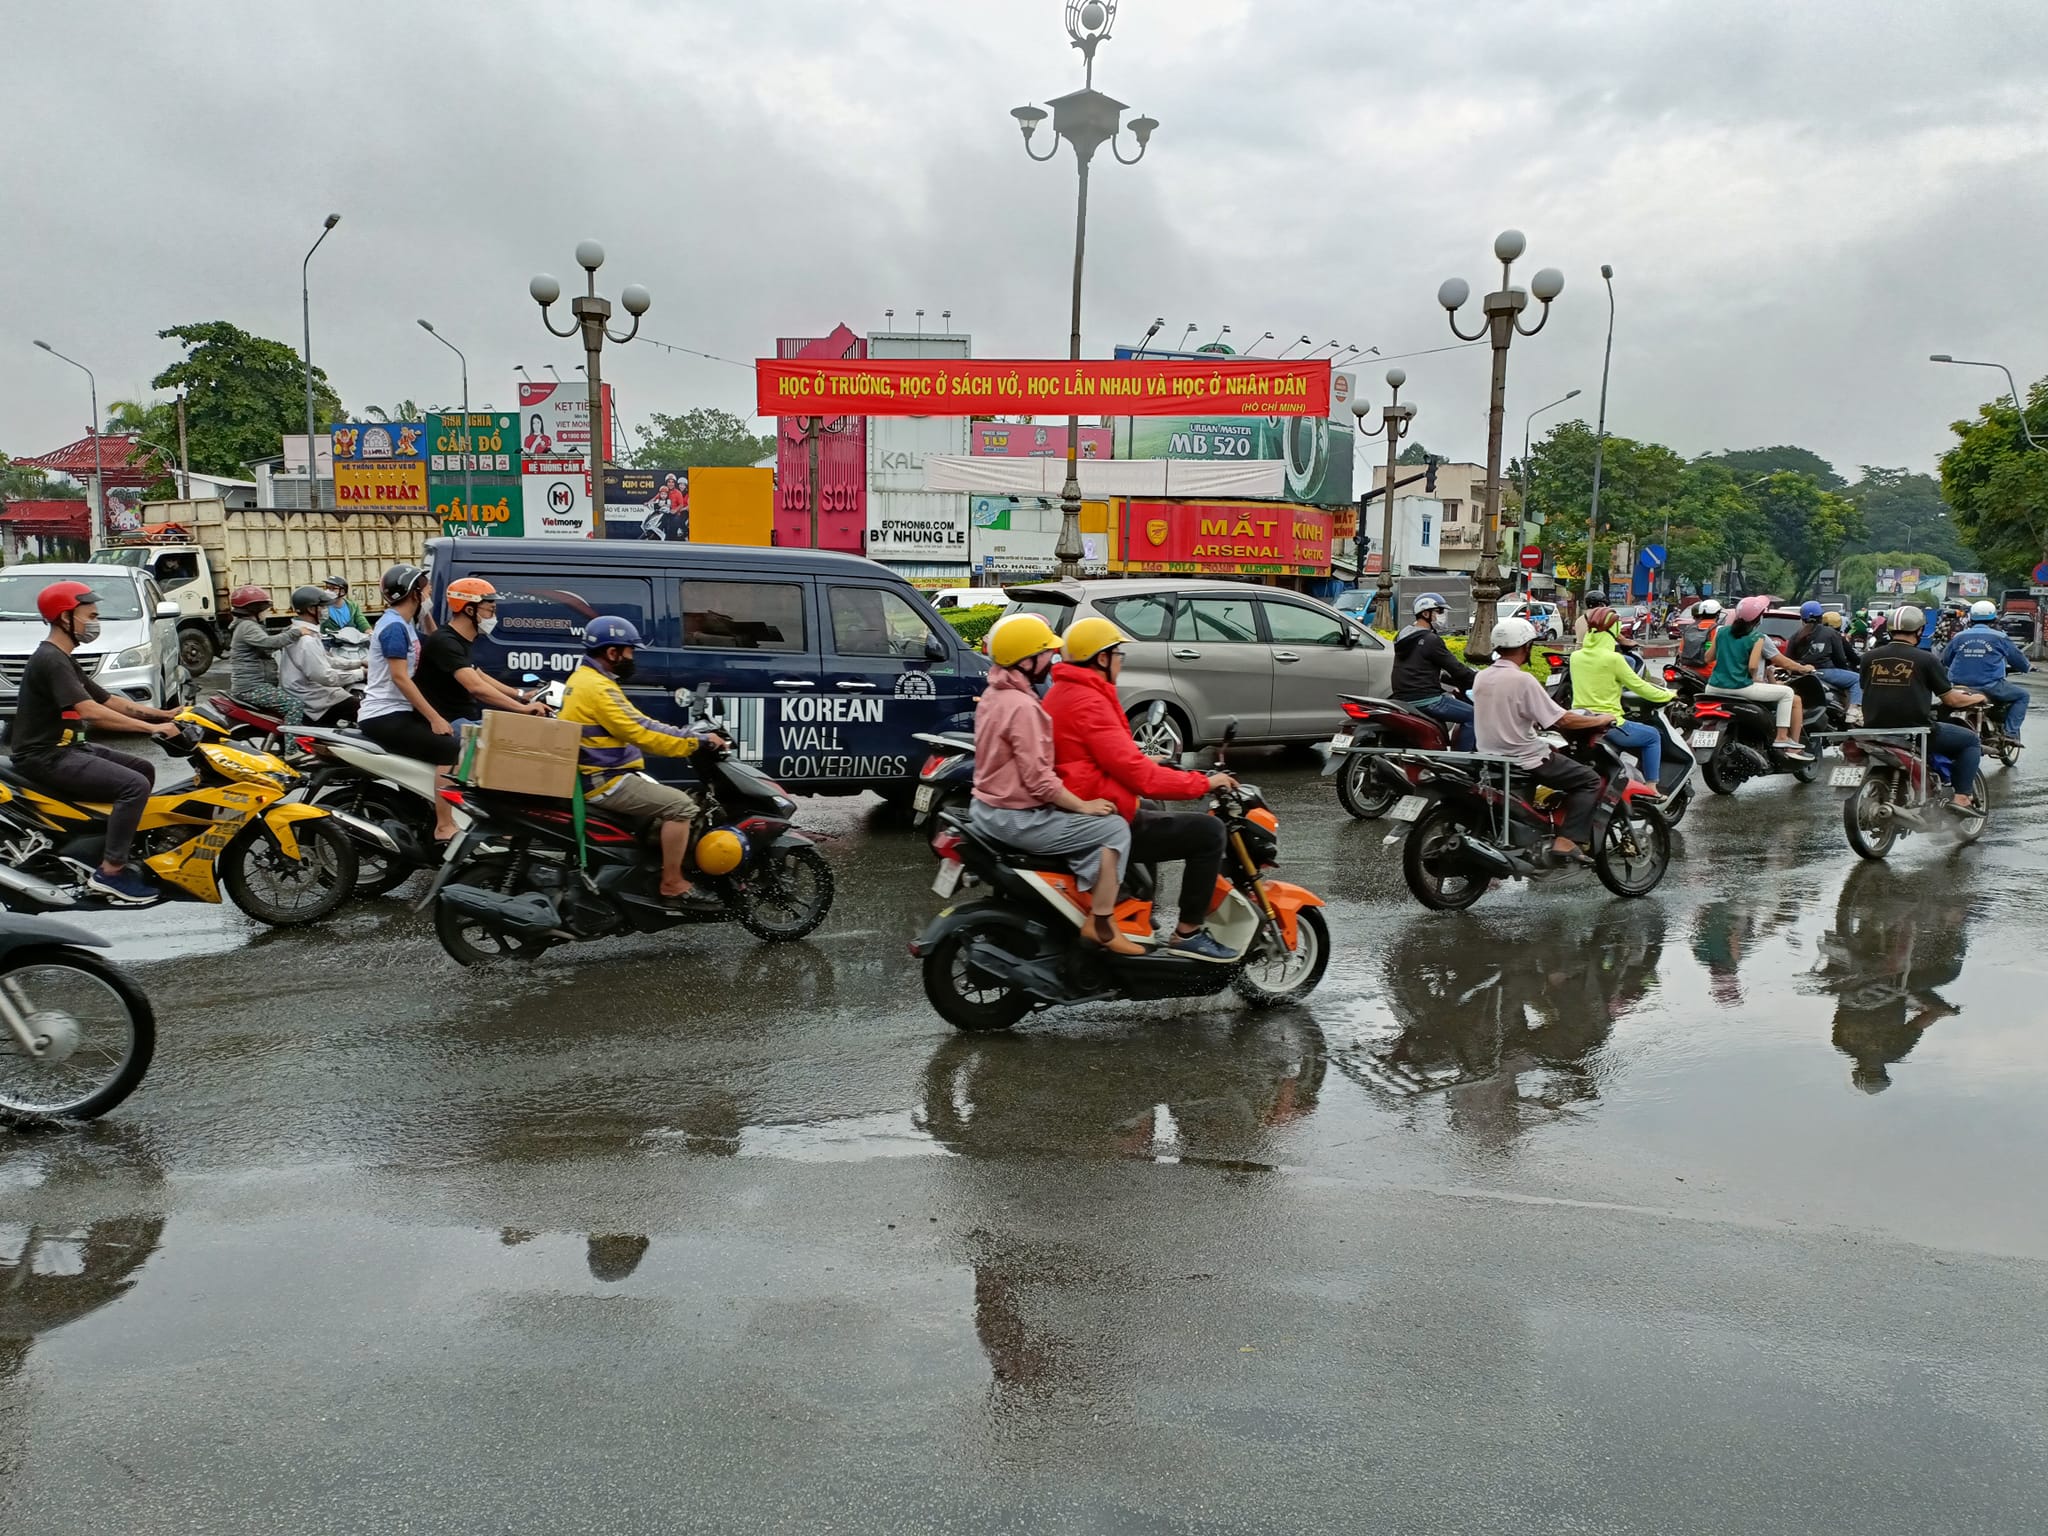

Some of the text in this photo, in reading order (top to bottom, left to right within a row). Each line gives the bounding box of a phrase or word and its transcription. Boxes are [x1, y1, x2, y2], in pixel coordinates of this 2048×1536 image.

[779, 369, 1307, 399] HỌC Ở TRƯỜNG, HỌC Ở SÁCH VỞ, HỌC LẪN NHAU VÀ HỌC Ở NHÂN DÂN
[1261, 402, 1277, 412] CHÍ
[1280, 402, 1306, 414] MINH)
[1189, 423, 1252, 435] URBAN MASTER
[478, 428, 502, 452] ĐỒ
[1168, 433, 1251, 456] MB 520
[528, 460, 579, 473] HỆ THỐNG CẦM
[340, 480, 420, 503] ĐẠI PHÁT
[622, 480, 638, 489] KIM
[639, 480, 655, 489] CHI
[822, 480, 858, 512] SƠN
[436, 496, 511, 522] CẦM ĐỒ
[542, 517, 583, 529] Vietmoney
[881, 520, 955, 530] EOTHON60.COM
[1200, 512, 1324, 542] MẮT KÍNH
[1334, 525, 1354, 538] KÍNH
[870, 529, 965, 544] BY NHUNG LE
[1192, 544, 1284, 559] ARSENAL
[1168, 563, 1196, 572] POLO
[1240, 563, 1282, 573] VALENTINO
[503, 617, 572, 630] DONGBEN
[507, 651, 583, 672] 60D-007
[781, 697, 884, 723] KOREAN
[779, 726, 844, 751] WALL
[779, 755, 907, 778] COVERINGS
